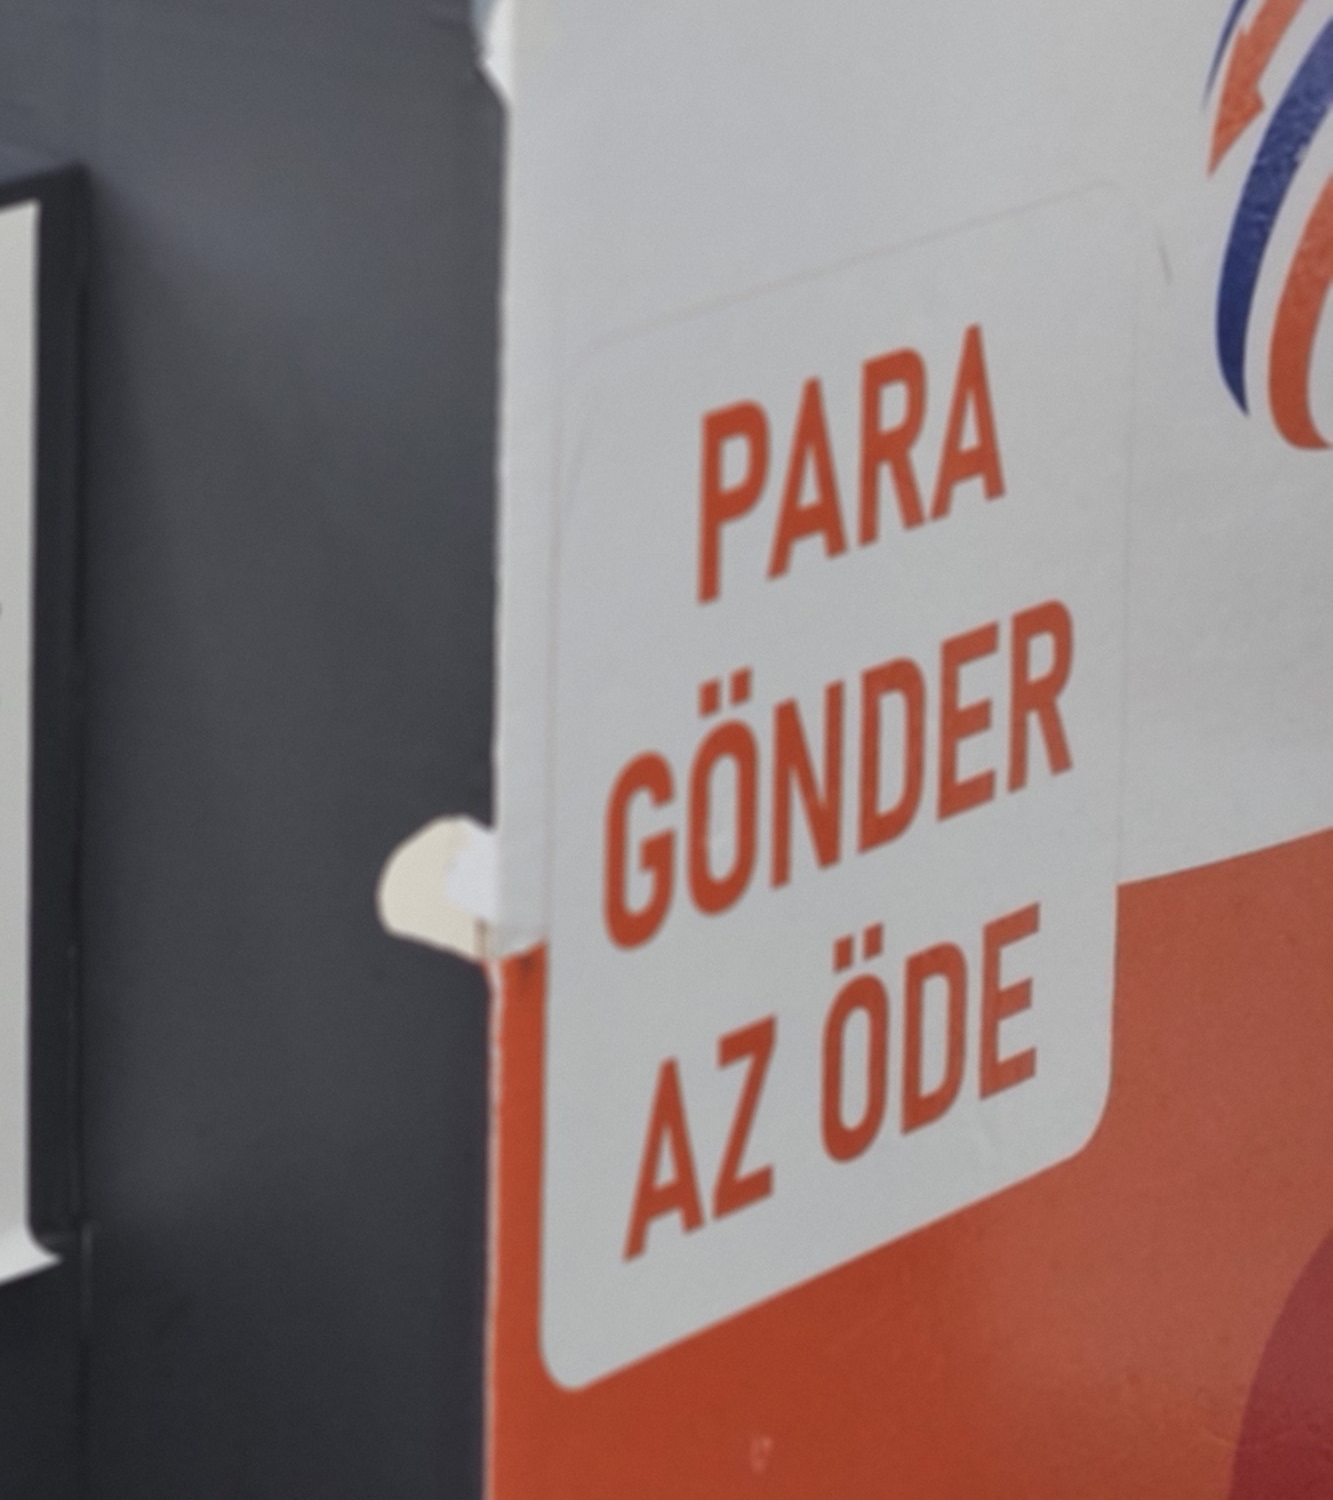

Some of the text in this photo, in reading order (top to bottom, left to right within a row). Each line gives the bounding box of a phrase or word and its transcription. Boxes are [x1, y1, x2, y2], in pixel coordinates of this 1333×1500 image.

[698, 324, 1006, 604] PARA
[603, 599, 1074, 950] GÖNDER
[622, 901, 1041, 1264] AZ ÖDE
